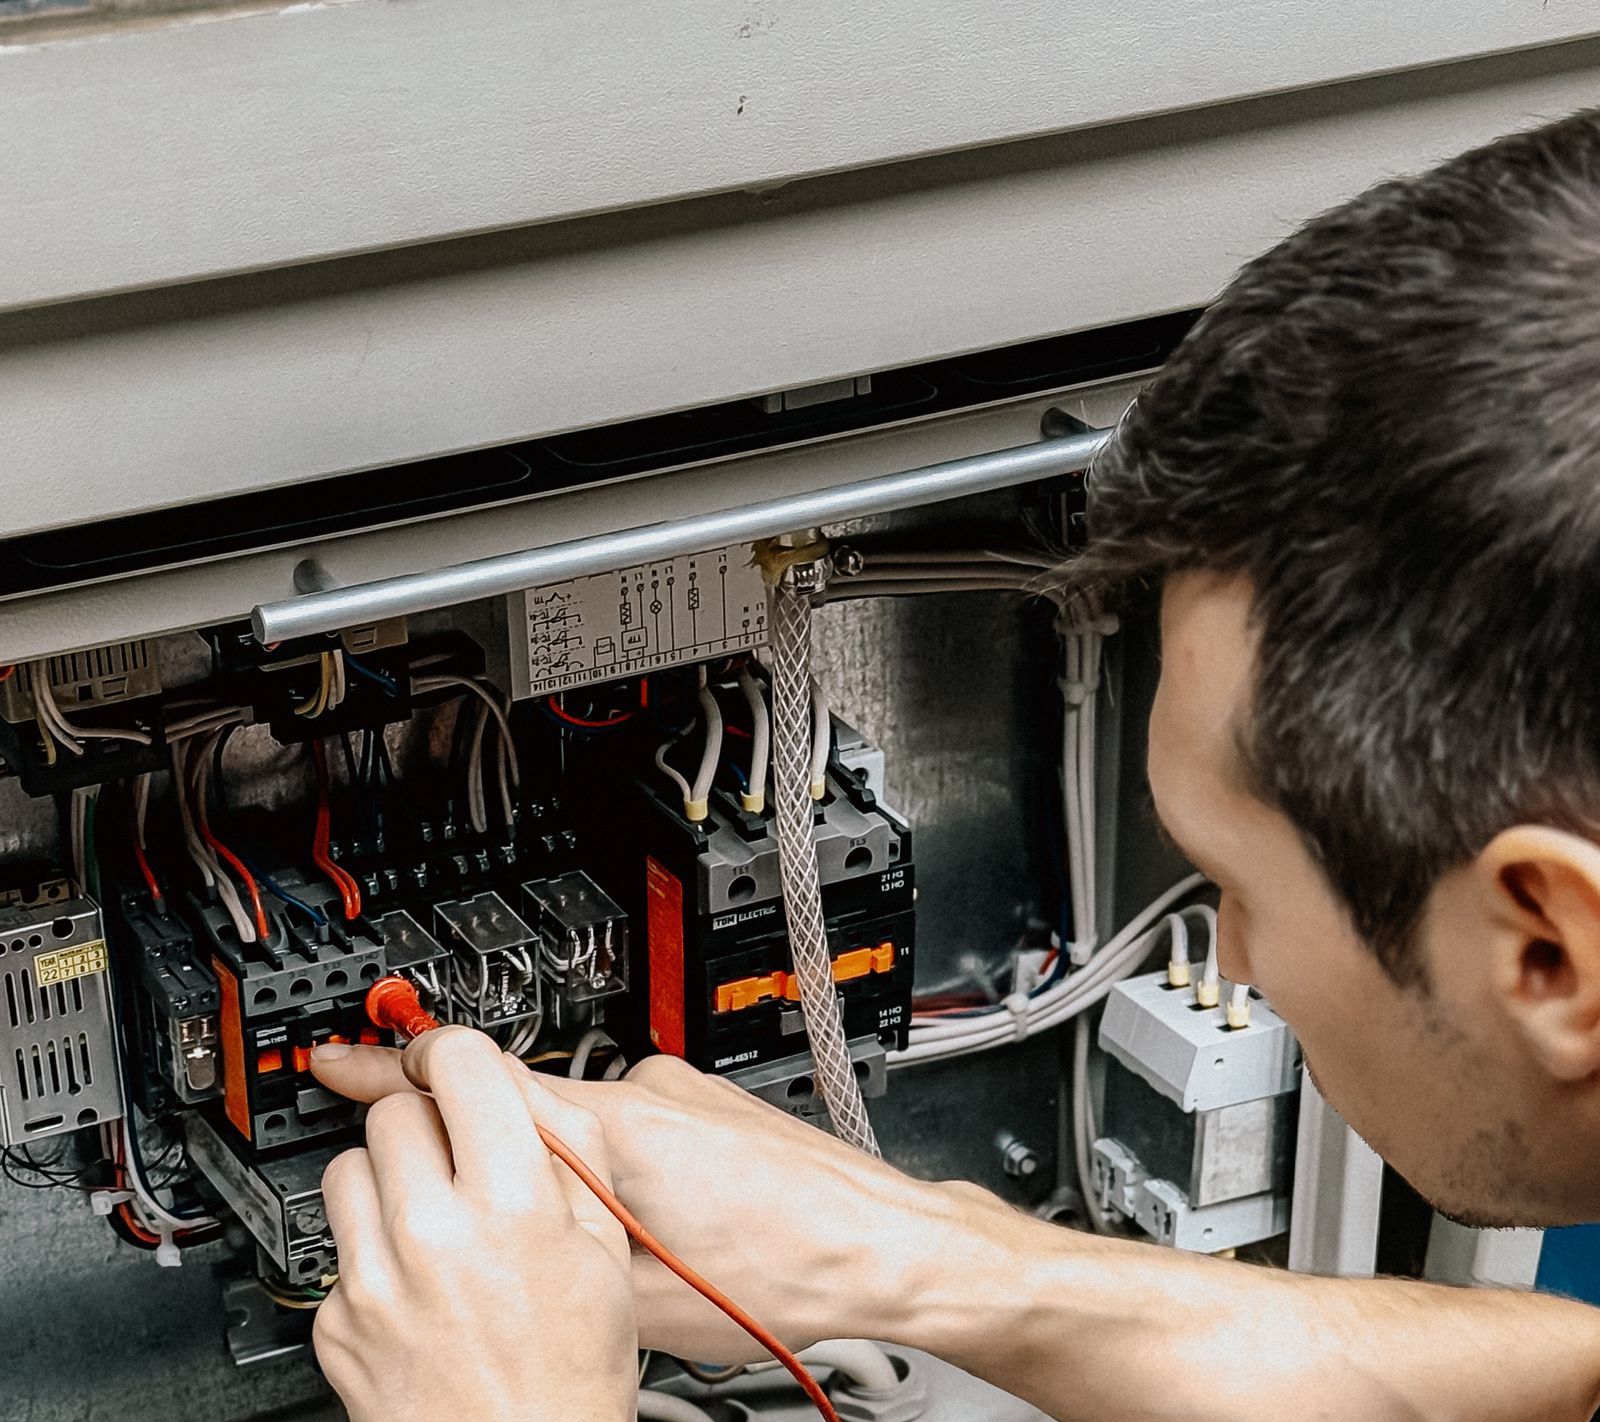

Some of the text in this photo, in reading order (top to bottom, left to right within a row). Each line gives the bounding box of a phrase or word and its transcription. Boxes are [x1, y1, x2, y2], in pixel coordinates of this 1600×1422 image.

[578, 672, 587, 681] 11
[592, 669, 602, 678] 10
[547, 680, 556, 689] 13
[562, 676, 572, 685] 12
[533, 682, 543, 692] 14
[881, 872, 891, 883] 21
[881, 882, 891, 892] 13
[739, 905, 776, 922] ELECTRIC
[900, 946, 910, 956] 11
[41, 956, 56, 968] YEAR
[43, 968, 58, 982] 22
[879, 1009, 888, 1018] 14
[879, 1018, 889, 1028] 22
